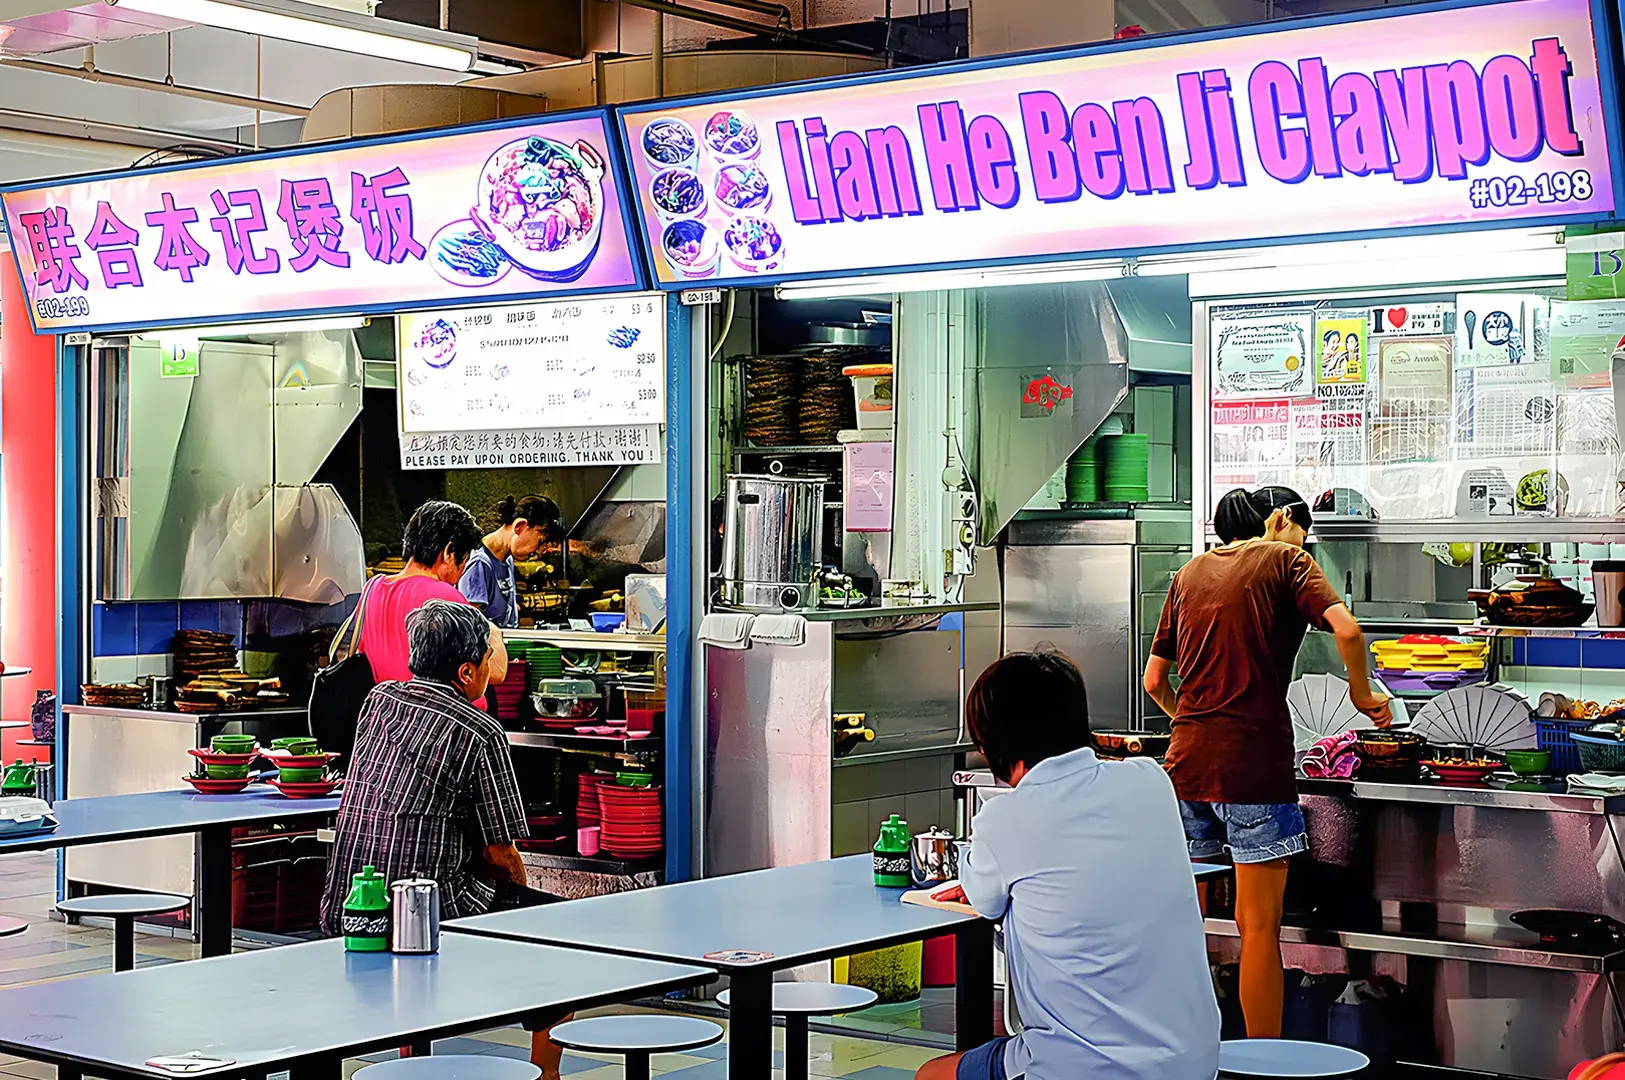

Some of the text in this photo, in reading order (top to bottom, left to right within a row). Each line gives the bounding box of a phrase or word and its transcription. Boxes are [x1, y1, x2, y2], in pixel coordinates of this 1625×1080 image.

[776, 37, 1584, 225] Lian He Ben Ji Claypot
[20, 166, 427, 293] 联合本记煲饭
[1470, 170, 1593, 208] #02-198
[405, 455, 446, 467] PLEASE
[451, 454, 469, 465] PAY
[474, 453, 504, 465] UPON
[509, 451, 570, 464] ORDERING.
[576, 450, 615, 462] THANK
[621, 449, 644, 461] YOU
